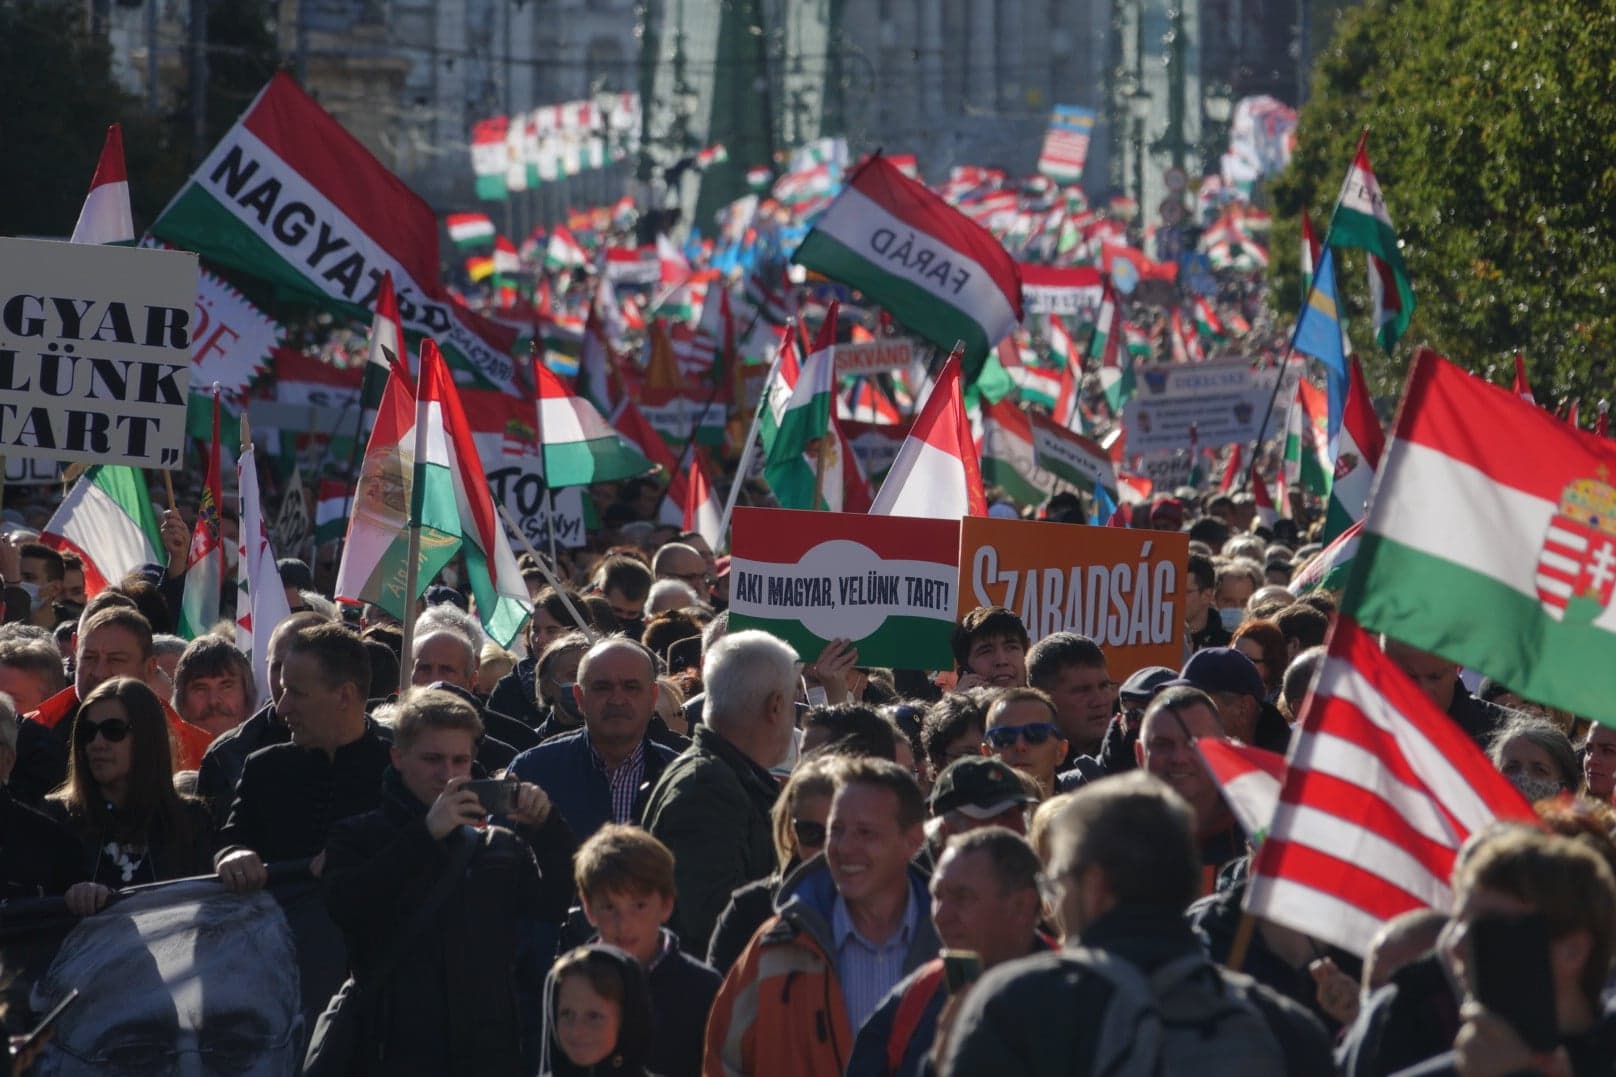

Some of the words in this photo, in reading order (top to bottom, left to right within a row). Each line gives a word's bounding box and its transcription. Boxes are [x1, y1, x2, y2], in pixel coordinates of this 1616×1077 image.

[3, 294, 191, 349] GYAR
[736, 571, 763, 604] AKI
[767, 576, 834, 609] MAGYAR,
[838, 571, 900, 606] VELÜNK
[905, 576, 949, 611] TART!
[972, 540, 1176, 647] SZABADSÁG
